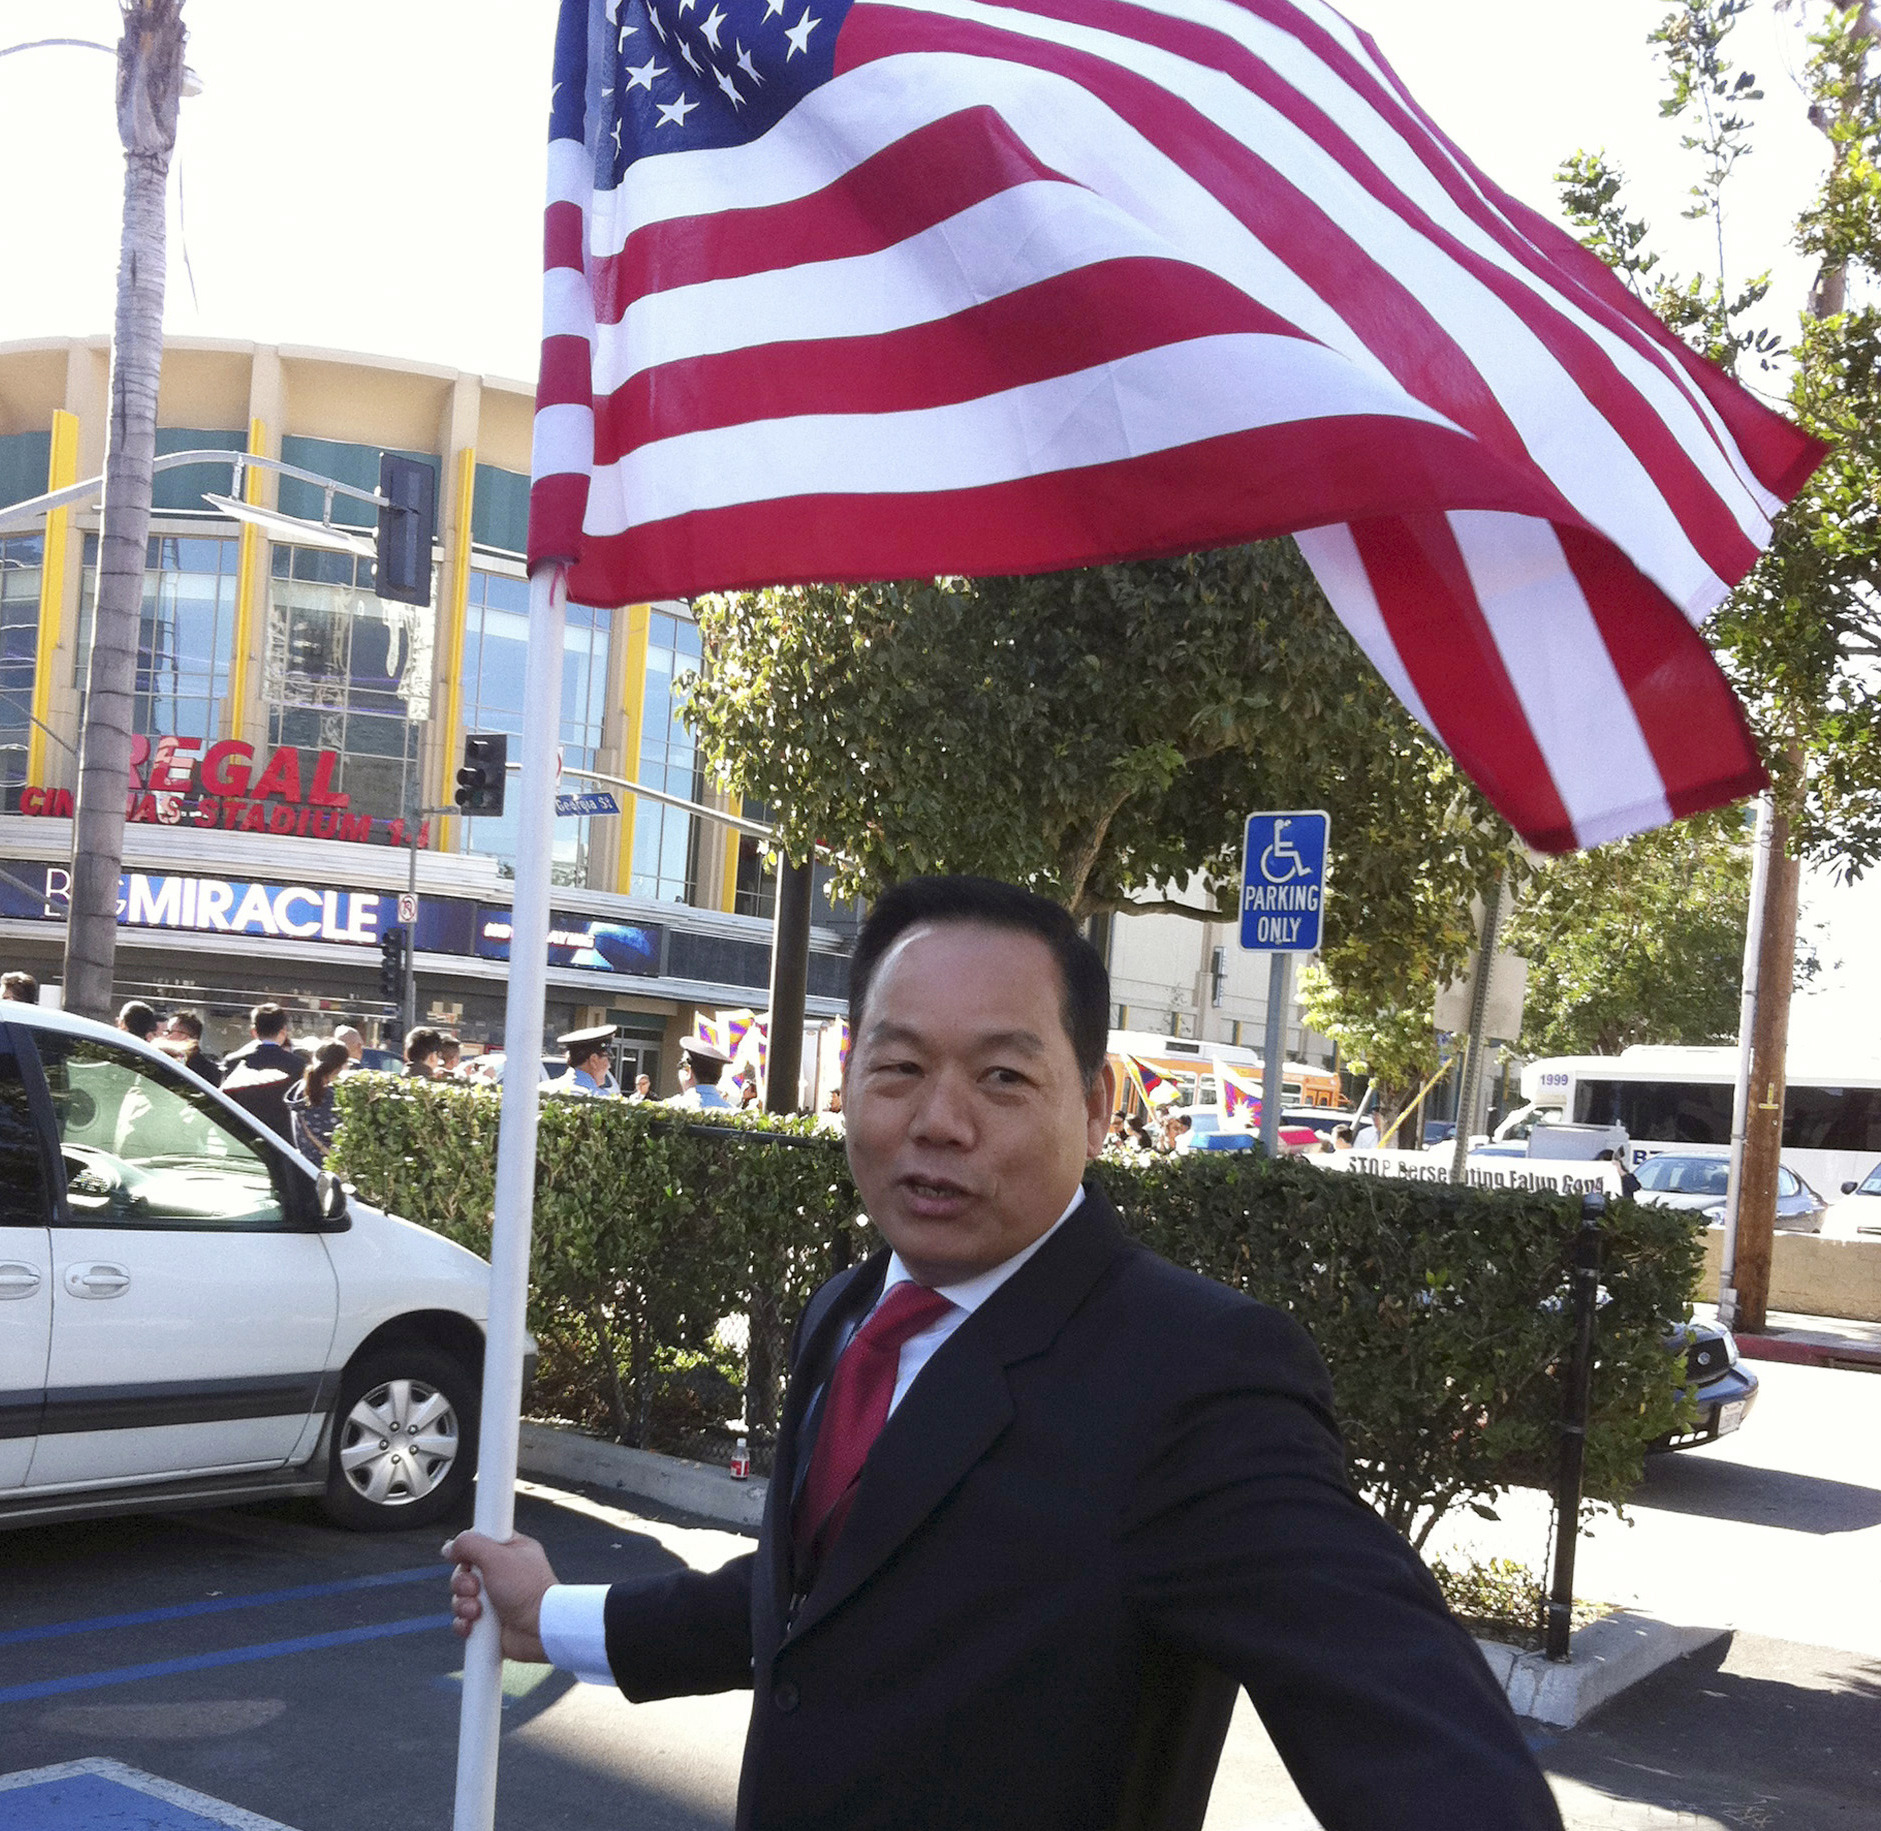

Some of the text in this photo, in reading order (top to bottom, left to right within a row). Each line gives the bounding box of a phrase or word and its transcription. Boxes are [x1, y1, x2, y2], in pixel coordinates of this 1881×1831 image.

[19, 786, 182, 825] CINAS
[183, 797, 373, 843] STADIUM
[555, 796, 613, 814] Georgia St
[1244, 885, 1320, 912] PARKING
[1257, 915, 1302, 944] ONLY
[1540, 1074, 1569, 1086] 1999
